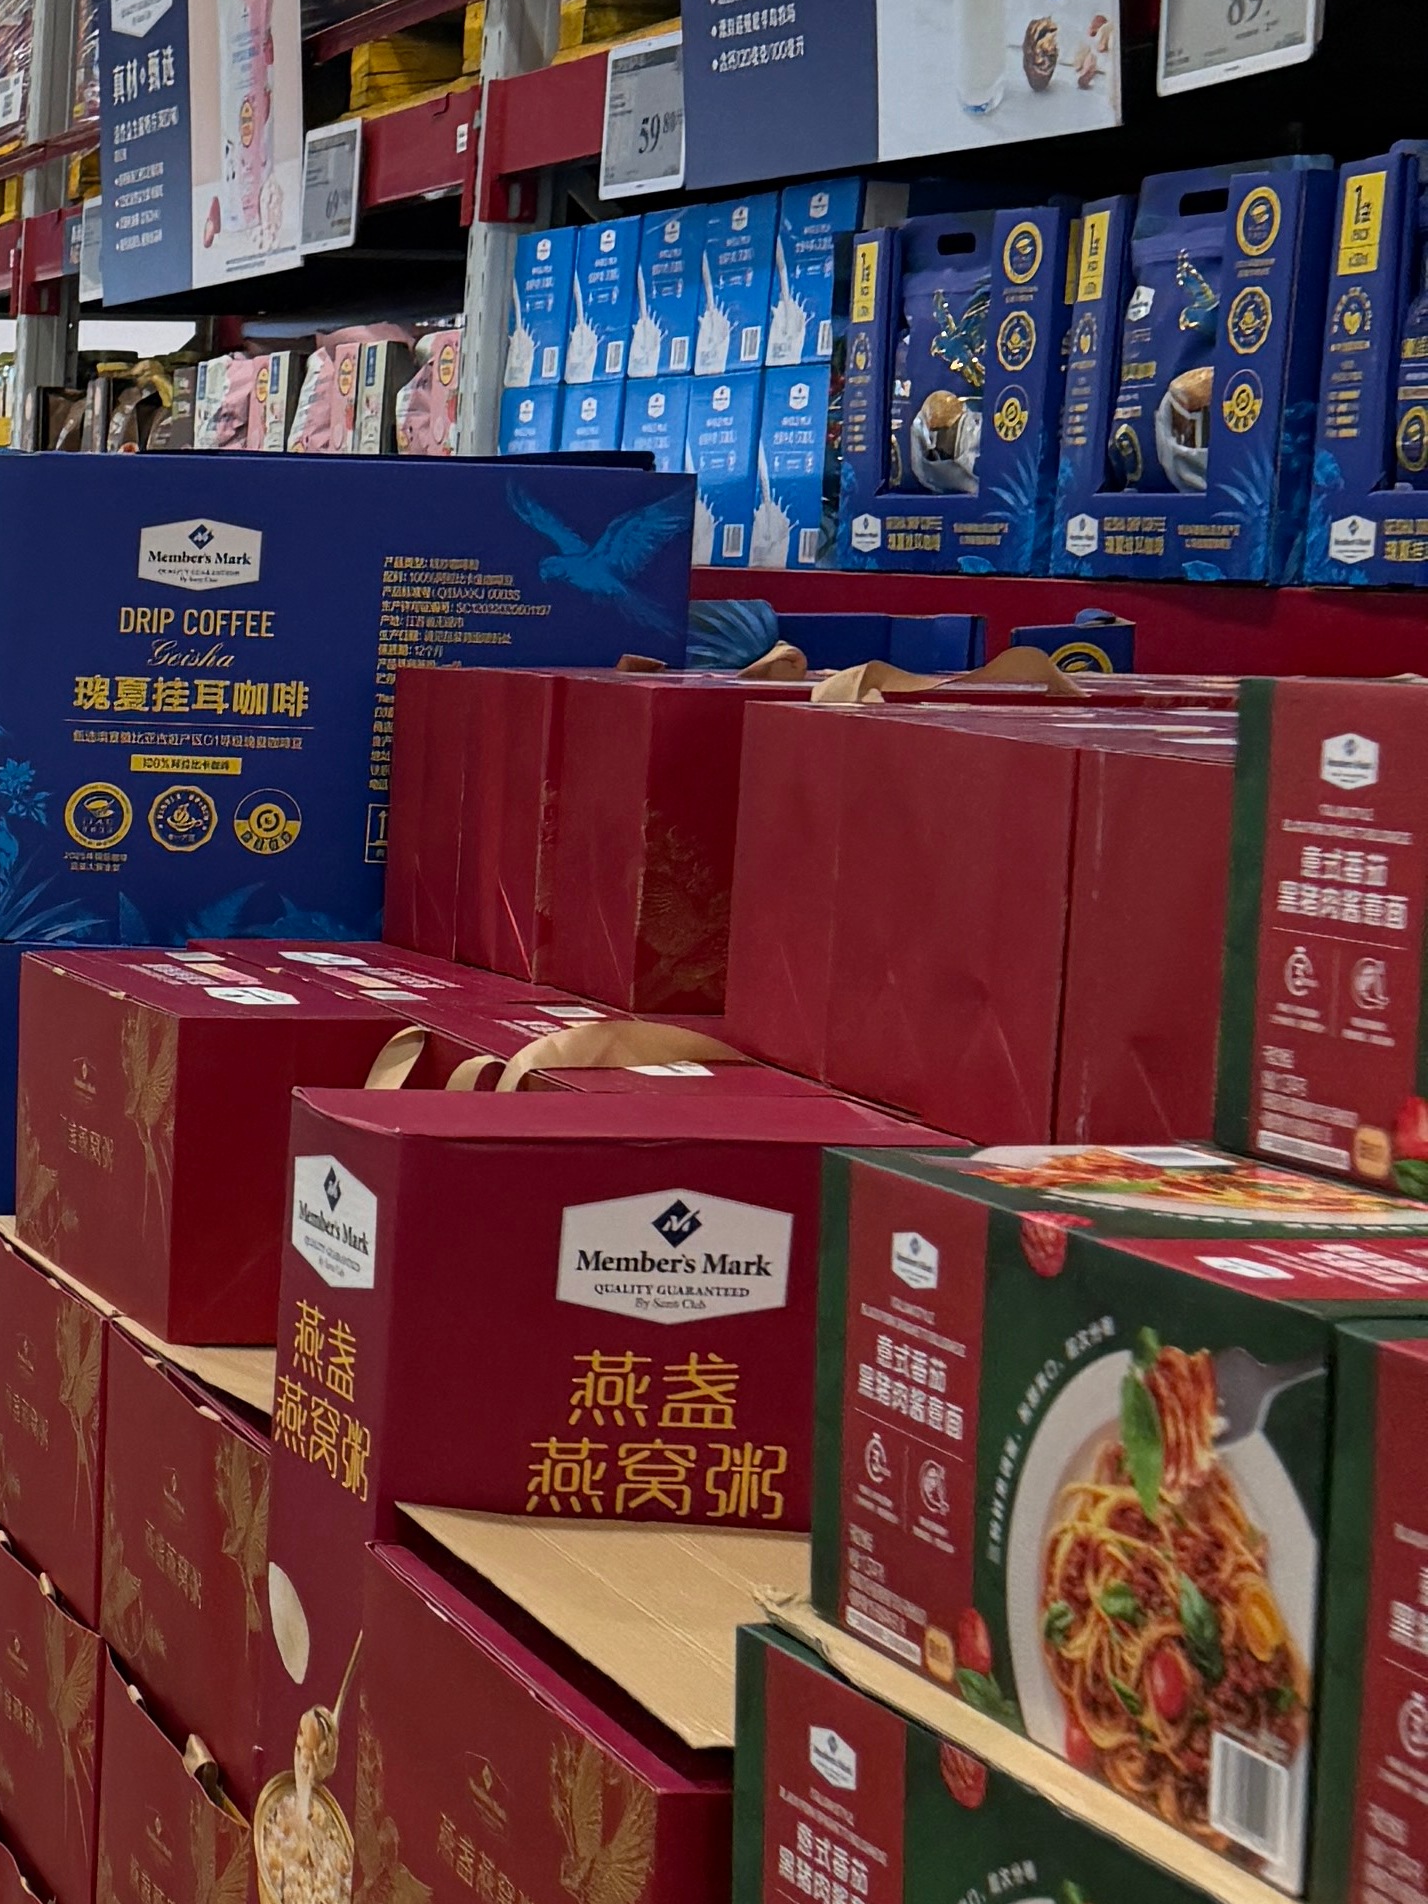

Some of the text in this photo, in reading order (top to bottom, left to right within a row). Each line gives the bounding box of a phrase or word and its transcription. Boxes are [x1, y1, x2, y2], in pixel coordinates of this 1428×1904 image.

[148, 550, 252, 566] Member's Mark
[120, 606, 276, 638] DRIP COFFEE
[147, 638, 236, 669] Geisha
[72, 674, 310, 718] 瑰夏挂耳咖啡
[298, 1199, 371, 1256] Member's Mark
[575, 1248, 773, 1278] Member's Mark
[594, 1283, 750, 1298] QUALITY GUARANTEED
[293, 1298, 357, 1404] 燕盏
[568, 1348, 741, 1431] 燕盏
[274, 1373, 372, 1504] 燕窝粥
[525, 1435, 788, 1521] 燕窝粥
